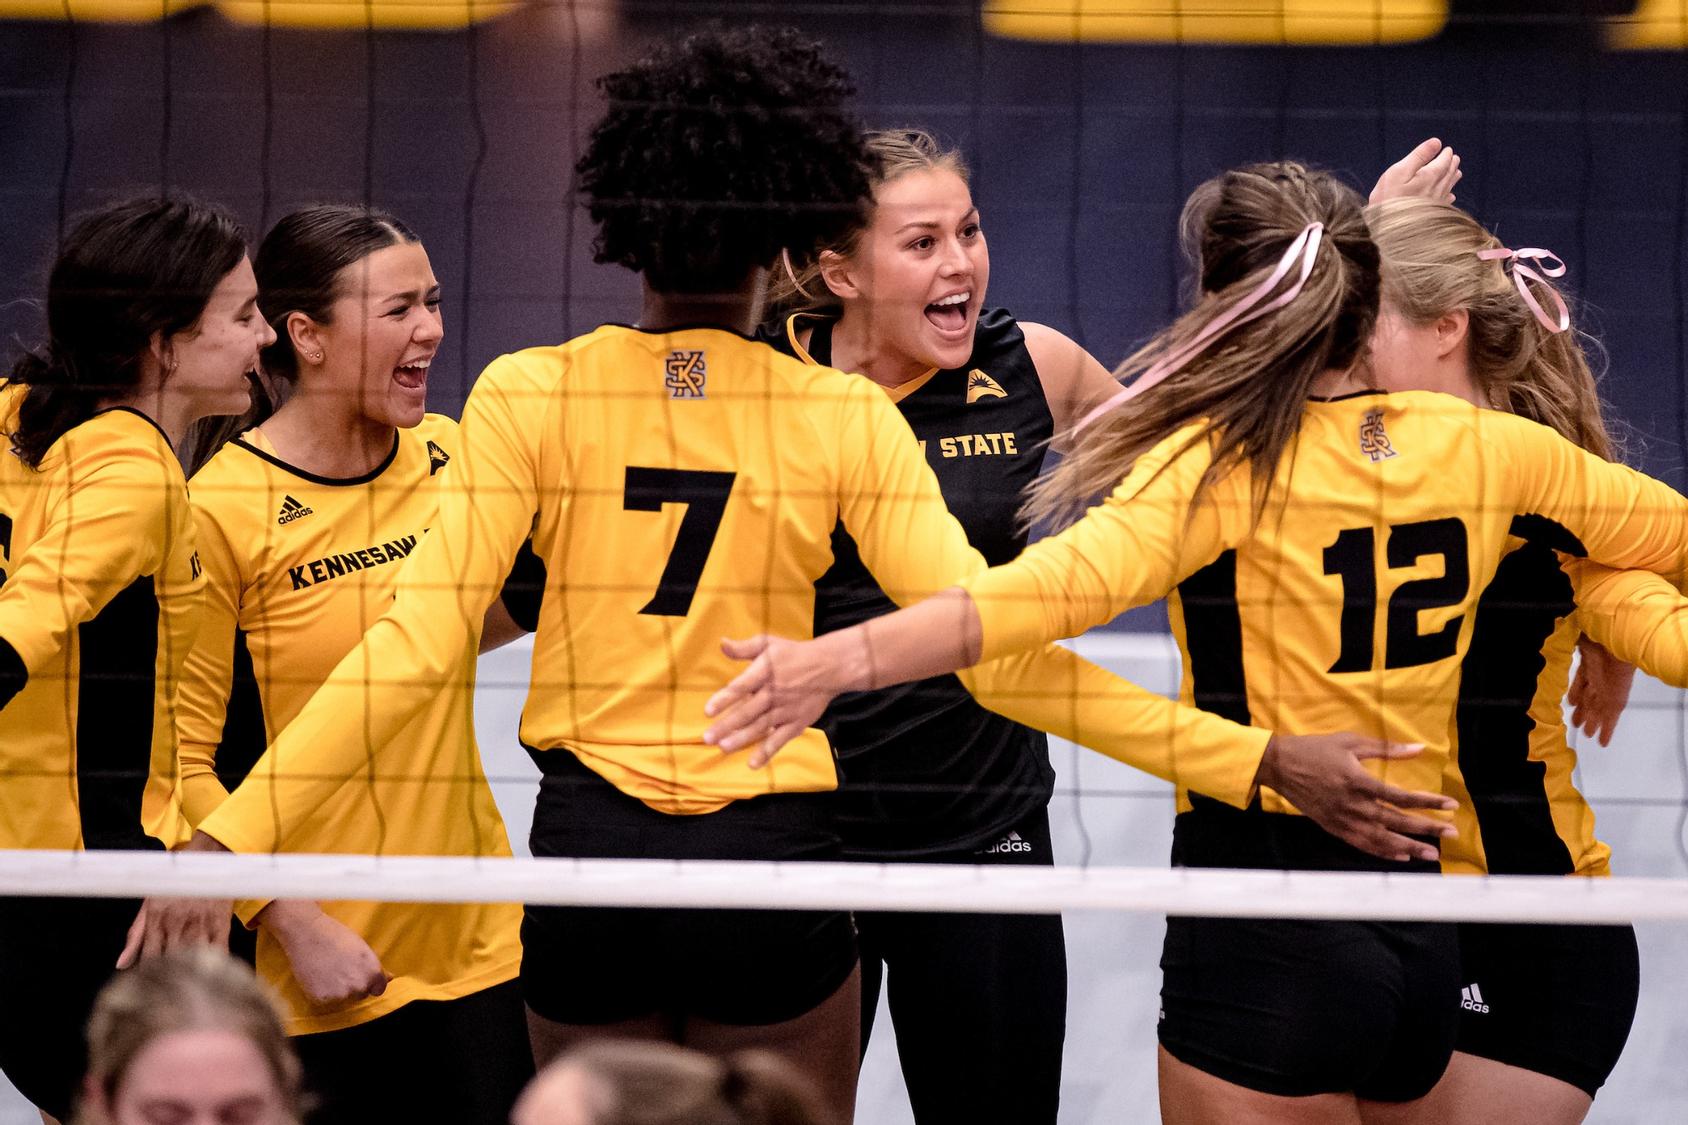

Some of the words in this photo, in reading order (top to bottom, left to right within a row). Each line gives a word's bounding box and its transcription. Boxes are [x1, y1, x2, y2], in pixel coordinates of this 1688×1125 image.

[940, 432, 1018, 458] STATE
[278, 506, 313, 525] adidas
[623, 466, 736, 617] 7
[288, 534, 417, 591] KENNESAW
[1322, 516, 1470, 674] 12
[974, 840, 1032, 854] idas
